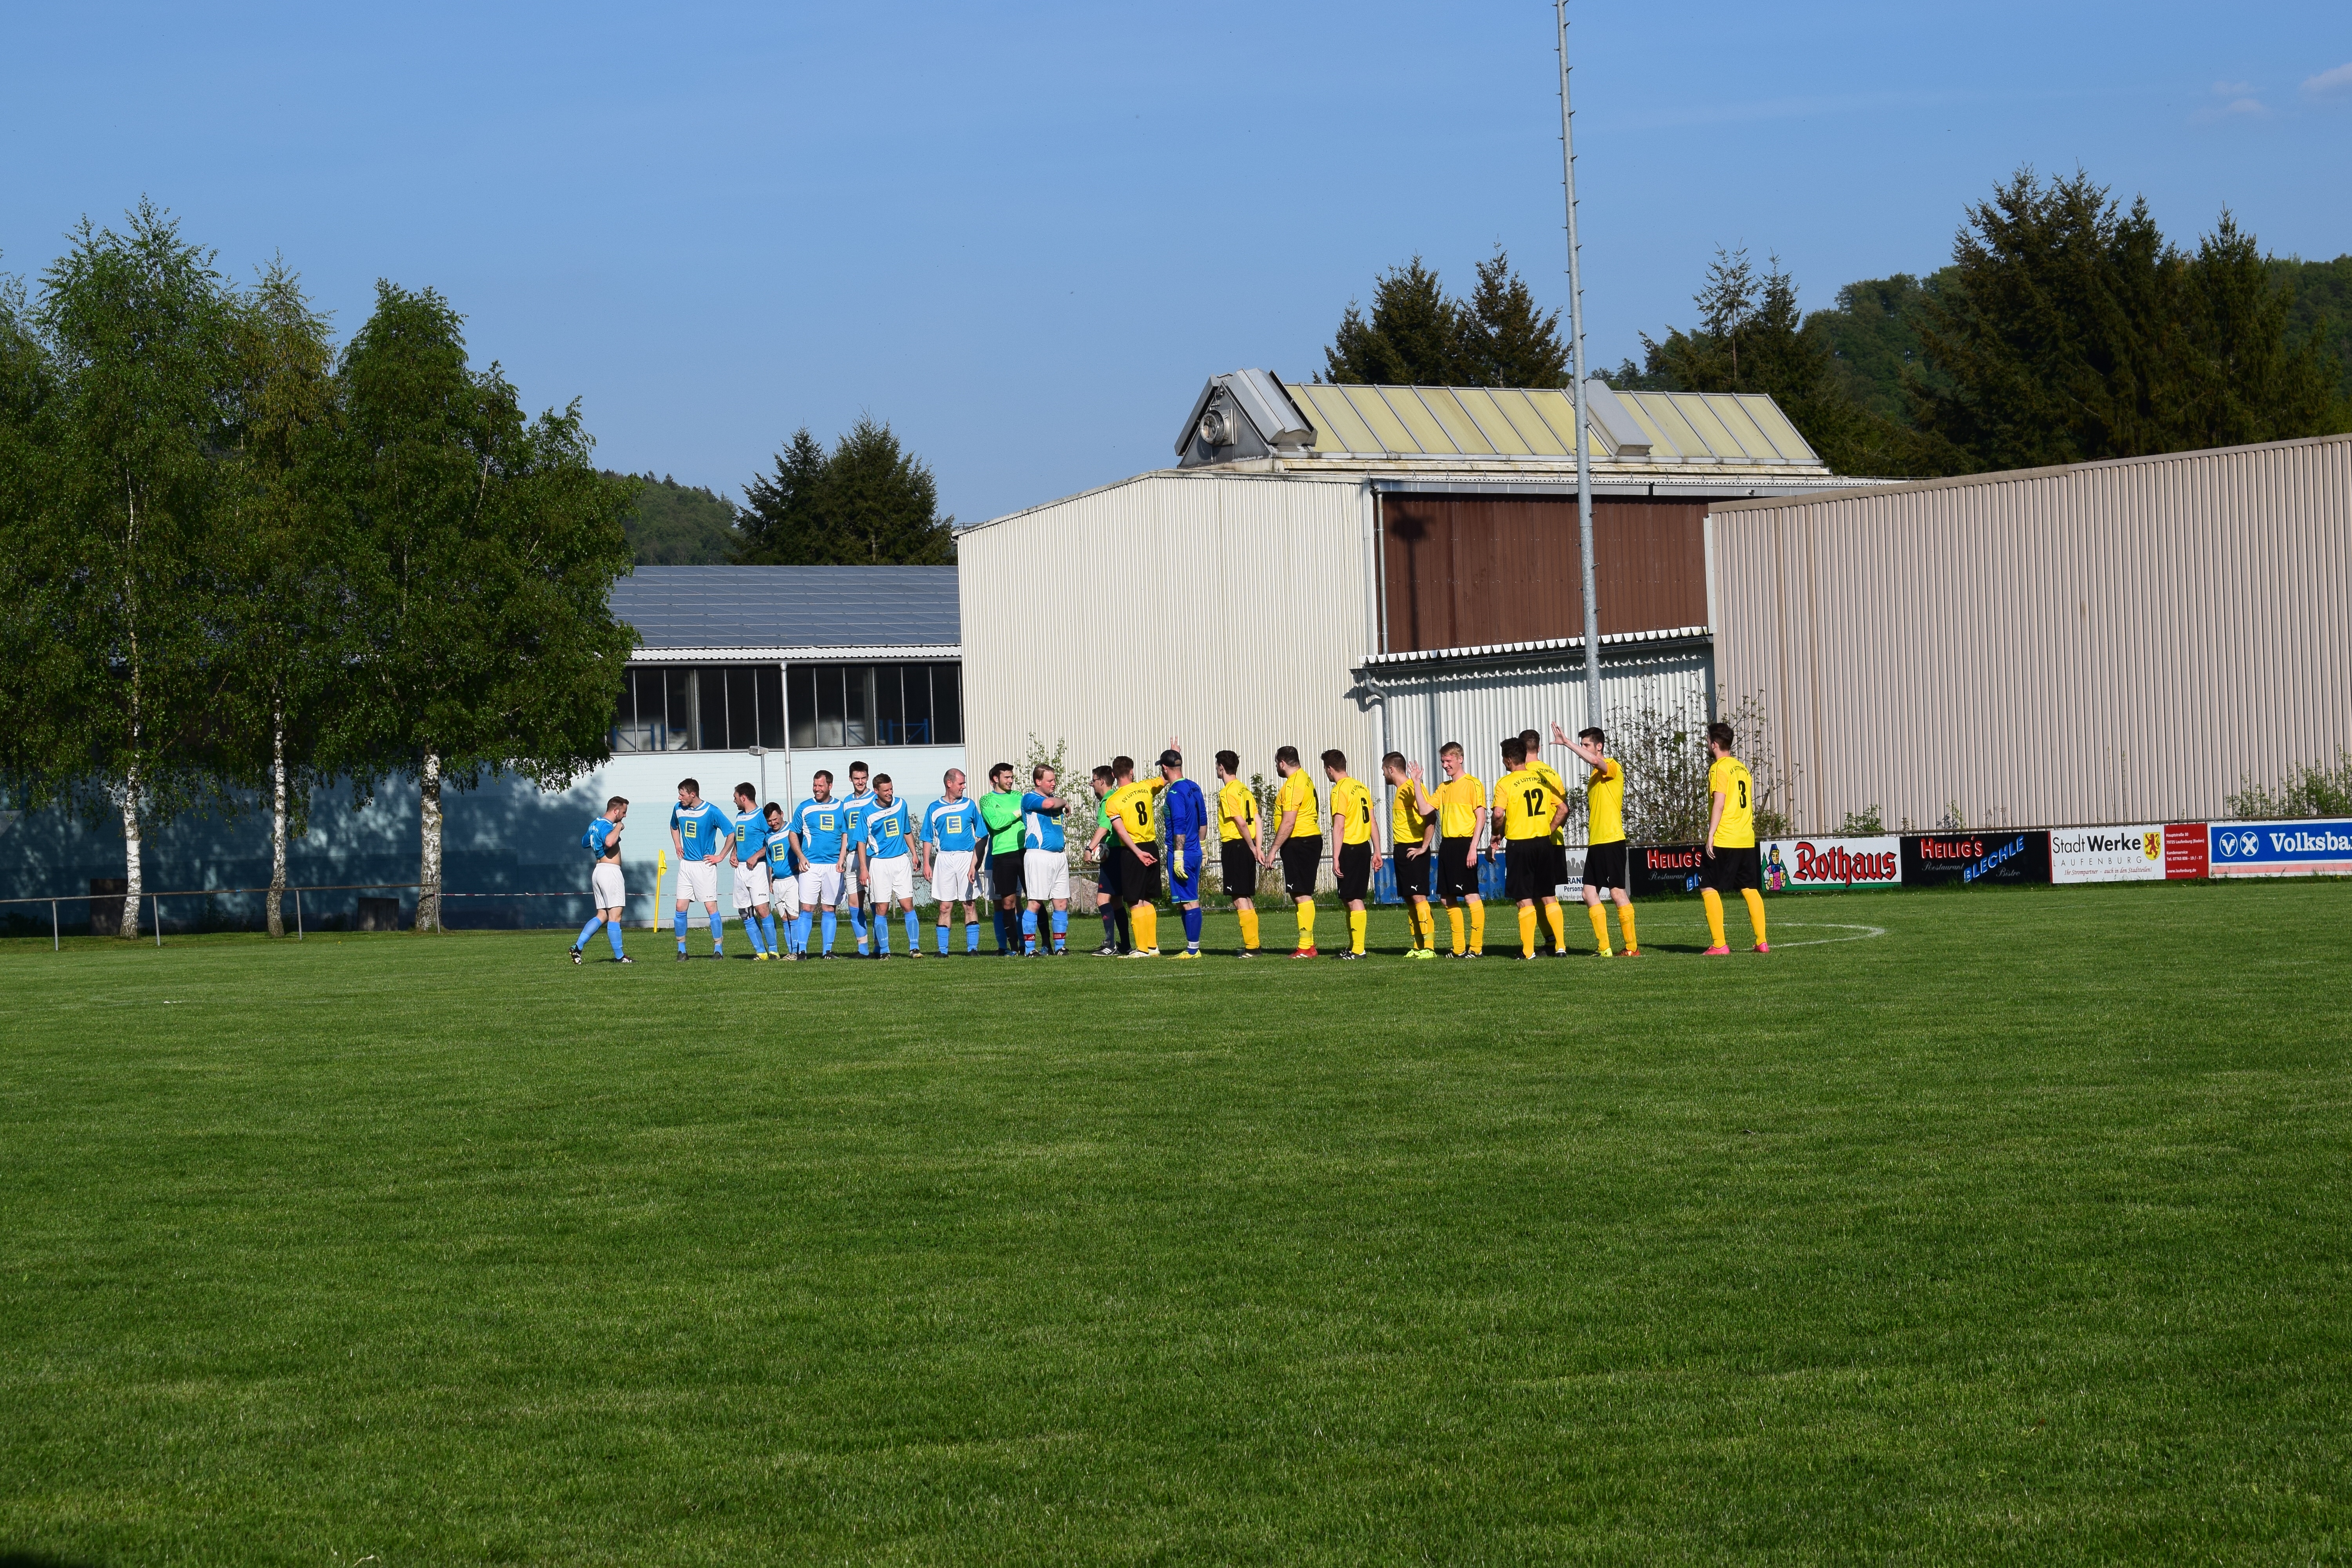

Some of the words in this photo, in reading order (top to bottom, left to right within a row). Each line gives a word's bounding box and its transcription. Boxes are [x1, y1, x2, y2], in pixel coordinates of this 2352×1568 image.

[1127, 789, 1149, 799] LUTTINGEN
[1523, 788, 1546, 817] 12
[1738, 780, 1747, 809] 3
[1135, 801, 1148, 826] 8
[1245, 800, 1254, 826] 4
[1361, 797, 1370, 824] 6
[687, 822, 695, 833] E
[822, 816, 833, 826] E
[886, 820, 897, 832] E
[948, 817, 960, 829] E
[737, 826, 744, 837] E
[1920, 835, 1984, 859] HEILIG'S
[2053, 833, 2085, 854] Stadt
[2087, 832, 2141, 852] Werke
[2269, 831, 2352, 852] Volksba
[774, 845, 783, 857] E
[1647, 847, 1702, 869] HEILIG'S
[1964, 835, 2024, 883] BLECHLE
[1793, 841, 1897, 888] Rothaus
[1922, 861, 1964, 871] Restaurant
[2053, 856, 2142, 867] LAUFENBURG
[1648, 871, 1686, 880] Restaurant
[1996, 867, 2020, 877] Bistro
[1686, 873, 1699, 891] BL
